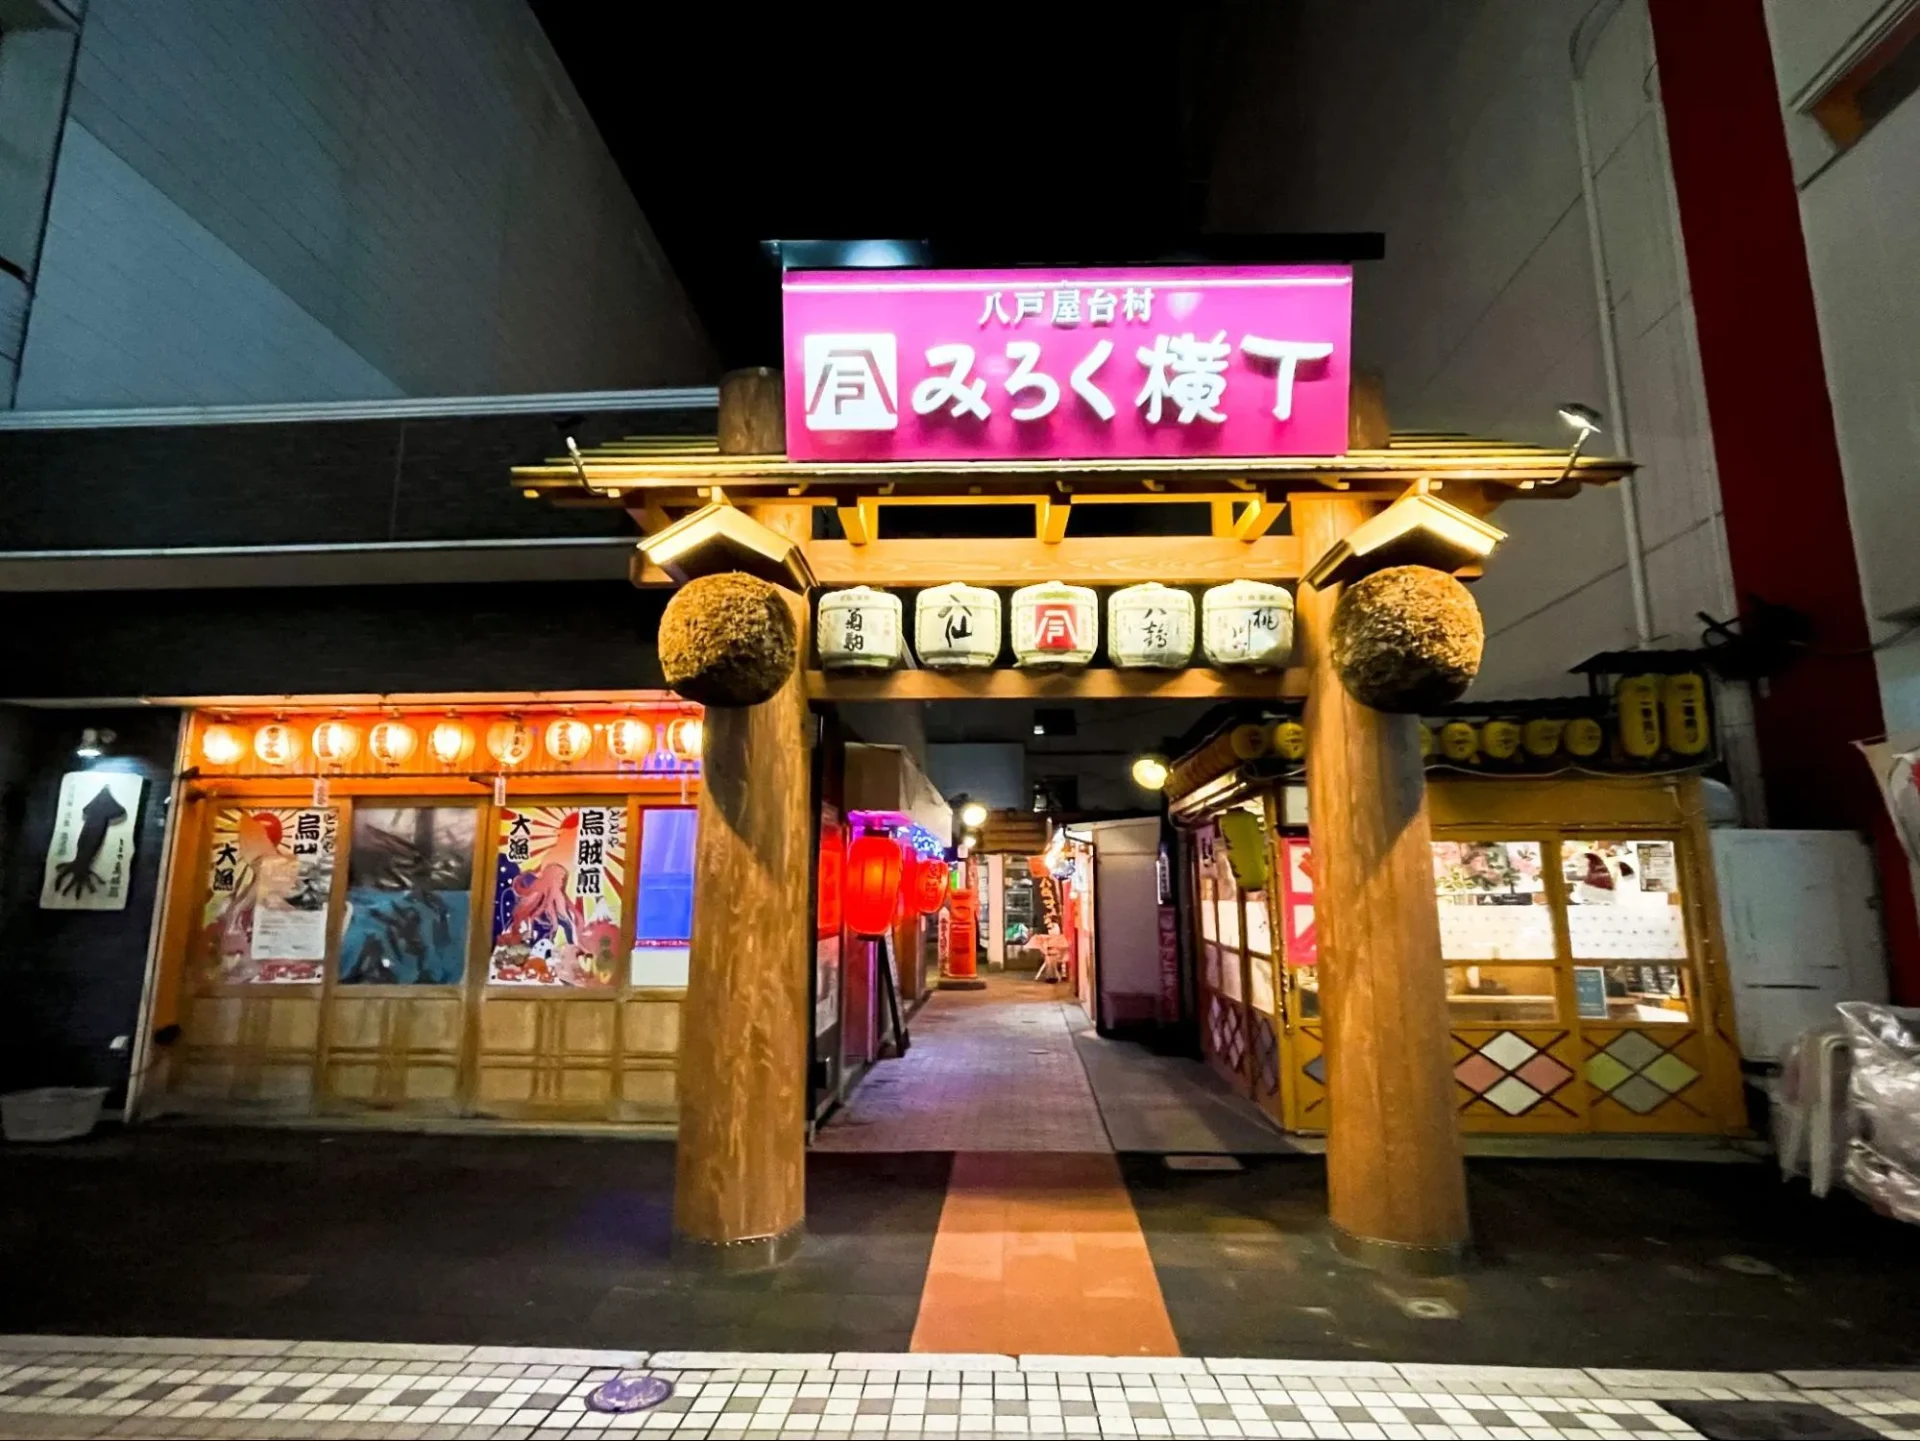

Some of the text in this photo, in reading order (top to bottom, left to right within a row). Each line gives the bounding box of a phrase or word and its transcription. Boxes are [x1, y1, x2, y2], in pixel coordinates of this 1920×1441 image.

[978, 288, 1156, 323] 八戸屋台村
[911, 329, 1334, 424] みろく横丁
[938, 594, 973, 648] 八仙
[508, 814, 531, 860] 大漁
[608, 810, 621, 848] ととや
[212, 843, 238, 892] 大漁
